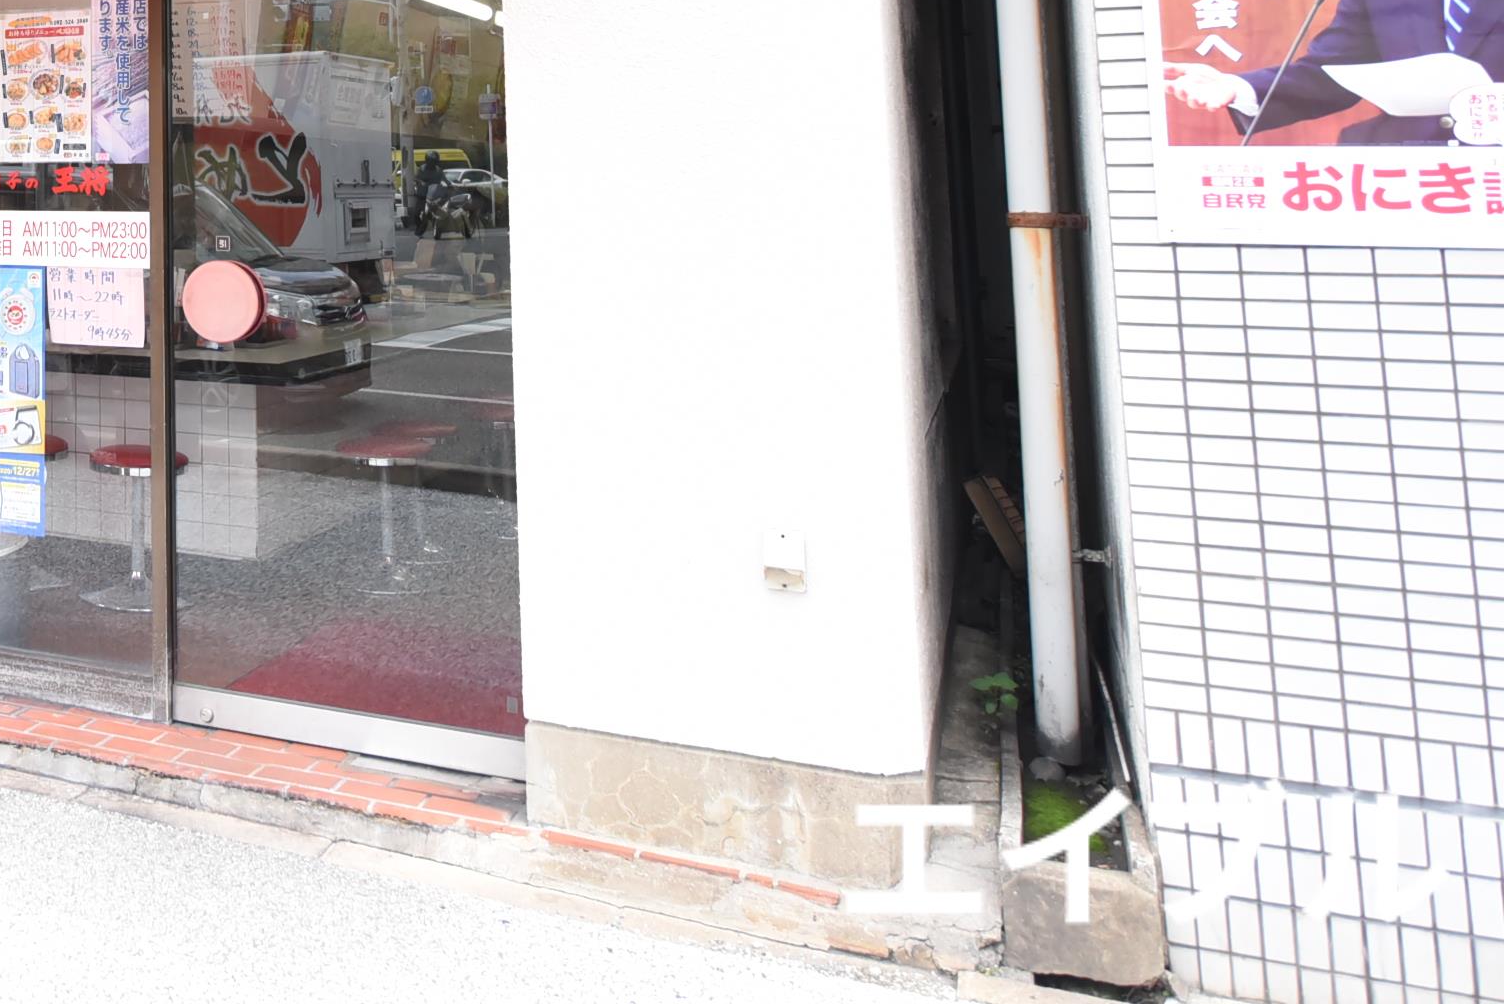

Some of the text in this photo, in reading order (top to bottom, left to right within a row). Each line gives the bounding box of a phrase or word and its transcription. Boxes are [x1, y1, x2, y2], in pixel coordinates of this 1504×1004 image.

[52, 166, 111, 196] 王将
[1202, 193, 1267, 209] 自民党
[49, 268, 114, 285] 営業時間
[87, 325, 133, 341] 9時45分
